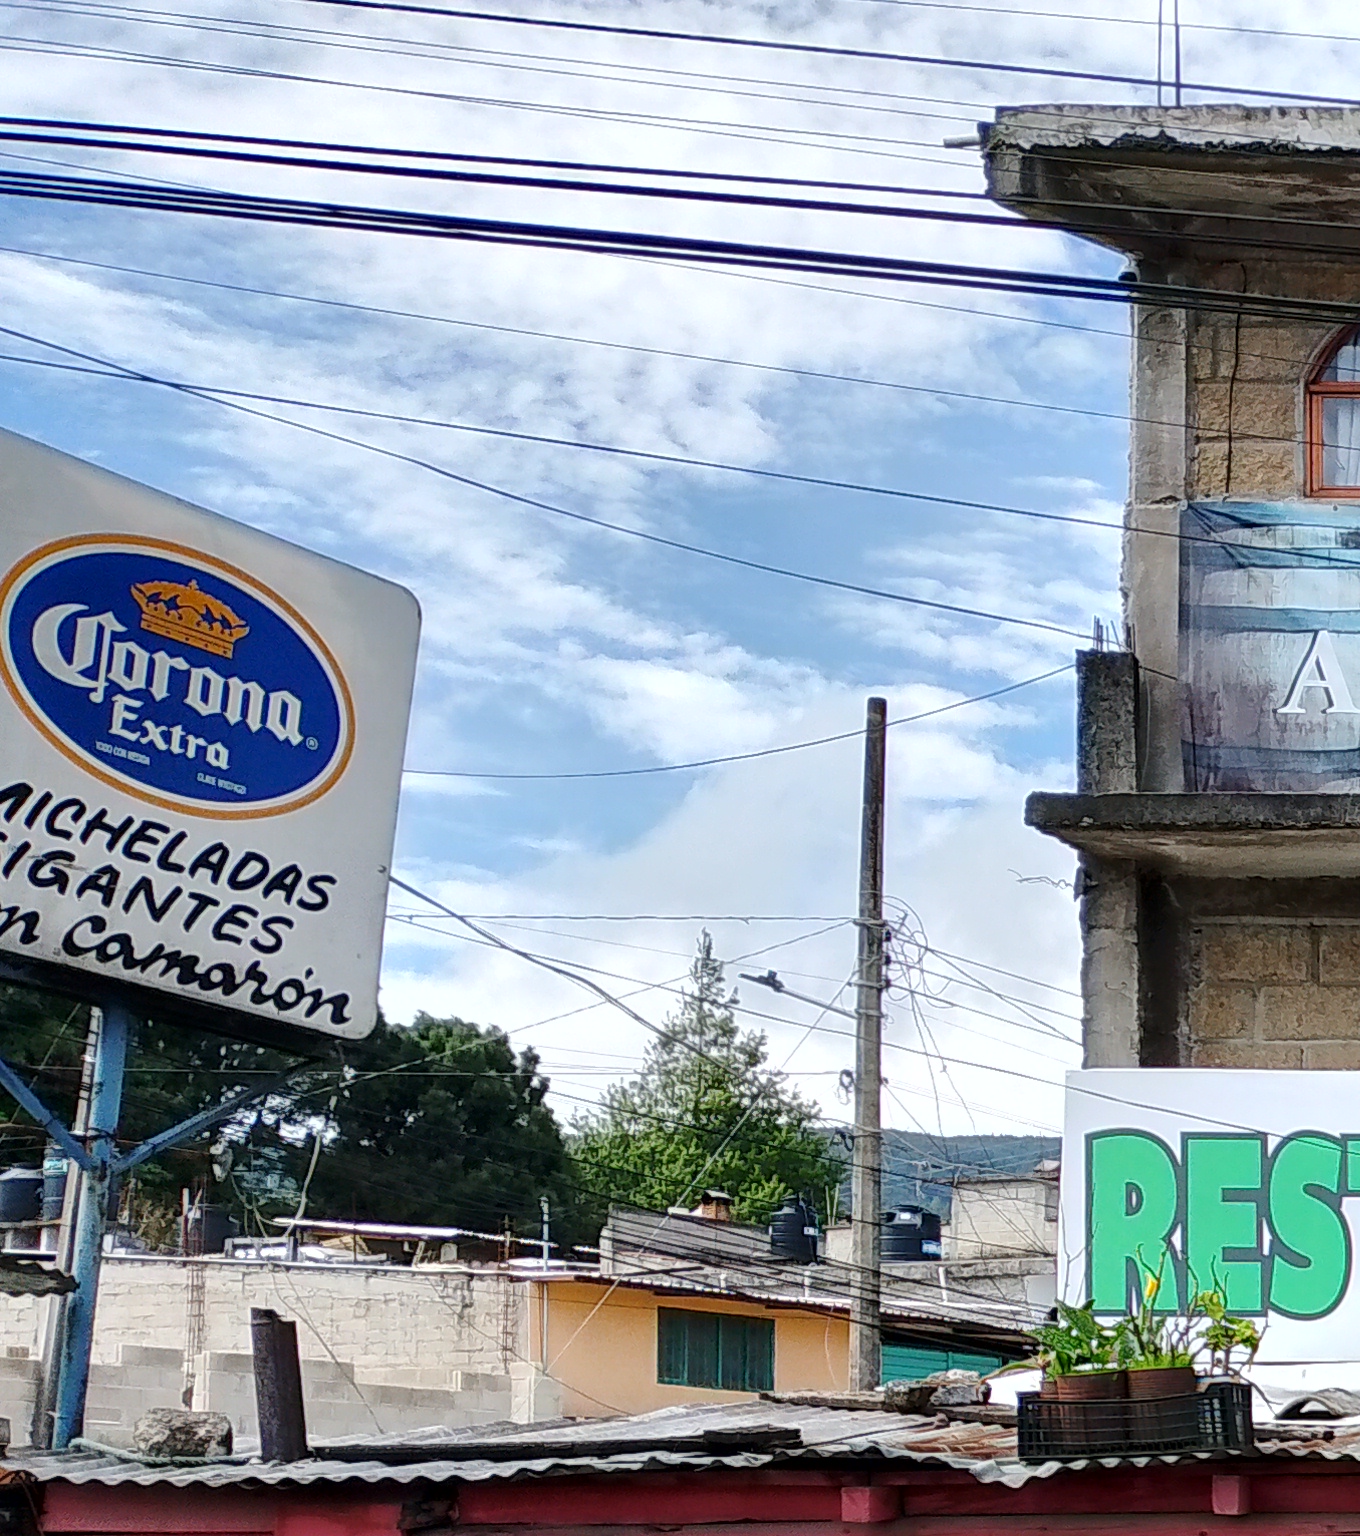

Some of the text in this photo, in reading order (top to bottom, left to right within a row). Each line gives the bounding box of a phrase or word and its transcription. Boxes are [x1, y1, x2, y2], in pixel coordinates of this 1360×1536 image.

[32, 603, 304, 746] Corona
[108, 694, 230, 770] Extra
[0, 831, 294, 954] IGANTES
